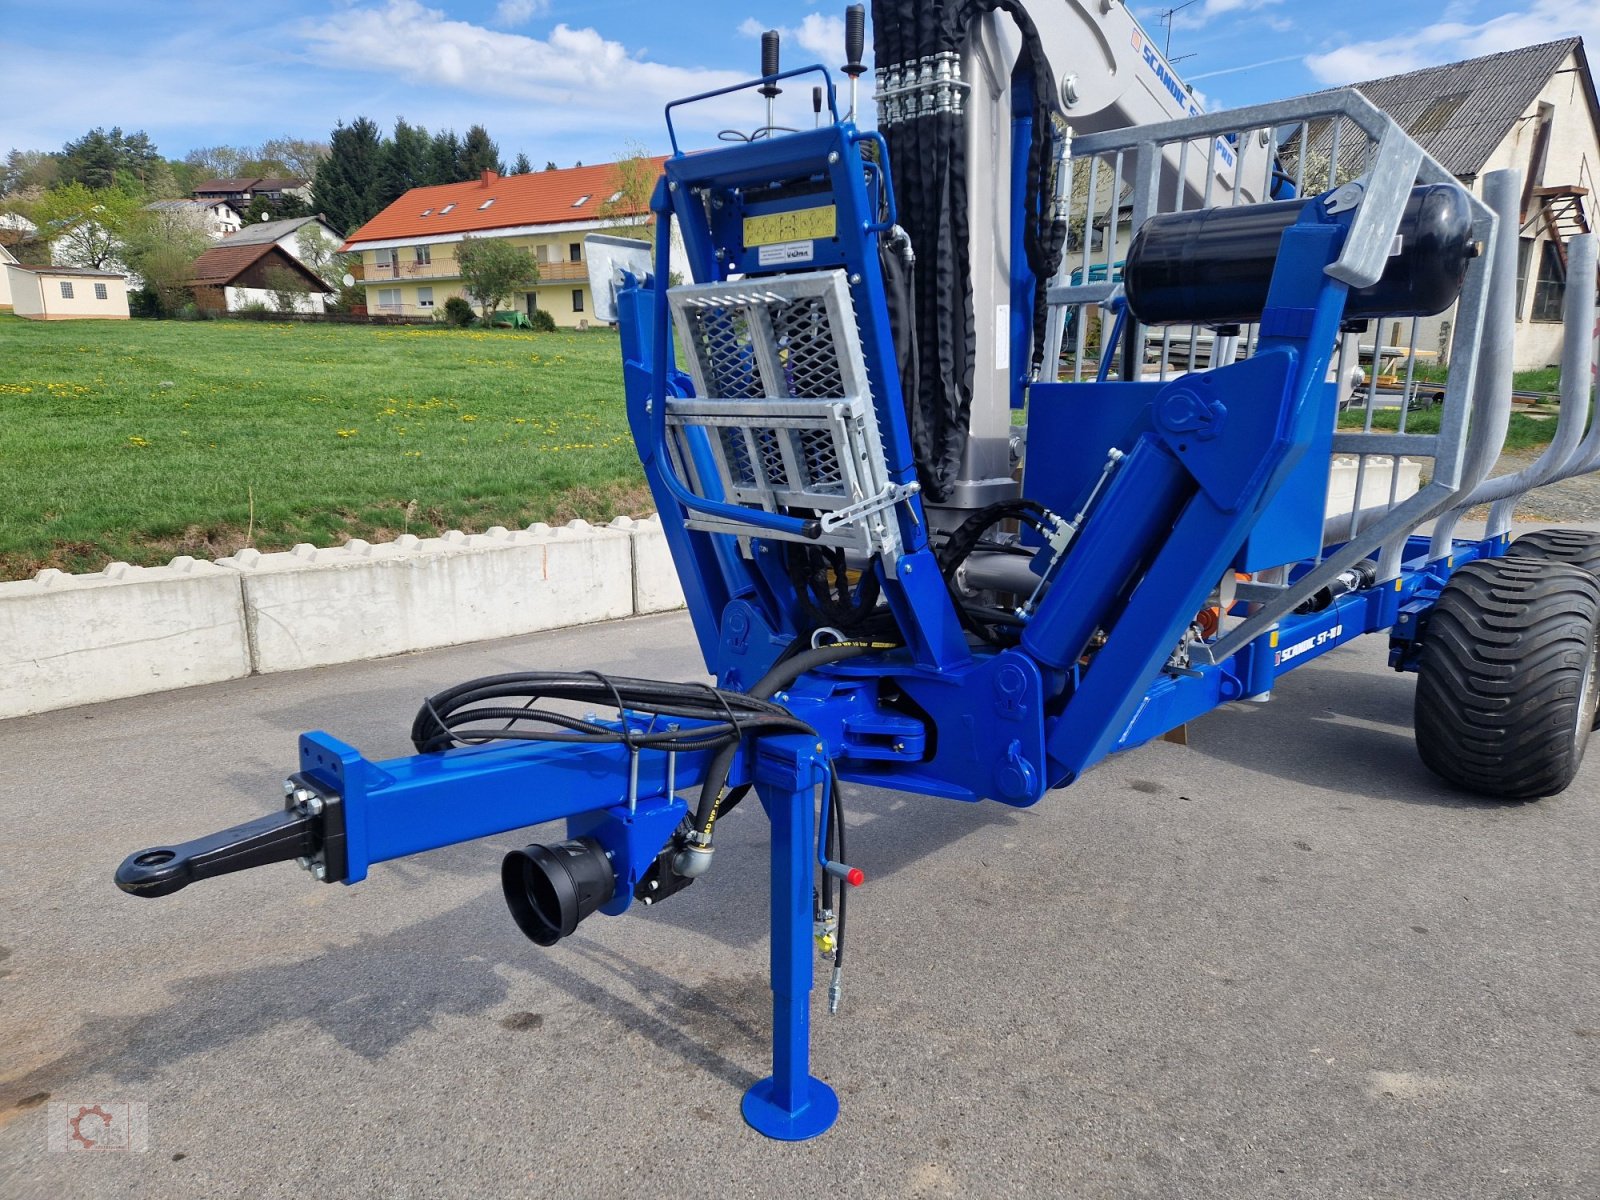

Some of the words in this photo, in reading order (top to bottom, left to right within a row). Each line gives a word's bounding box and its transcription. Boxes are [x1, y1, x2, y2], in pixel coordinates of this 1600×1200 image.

[1142, 44, 1187, 109] SCANDIC
[1215, 140, 1233, 168] PRO
[708, 809, 716, 822] WP
